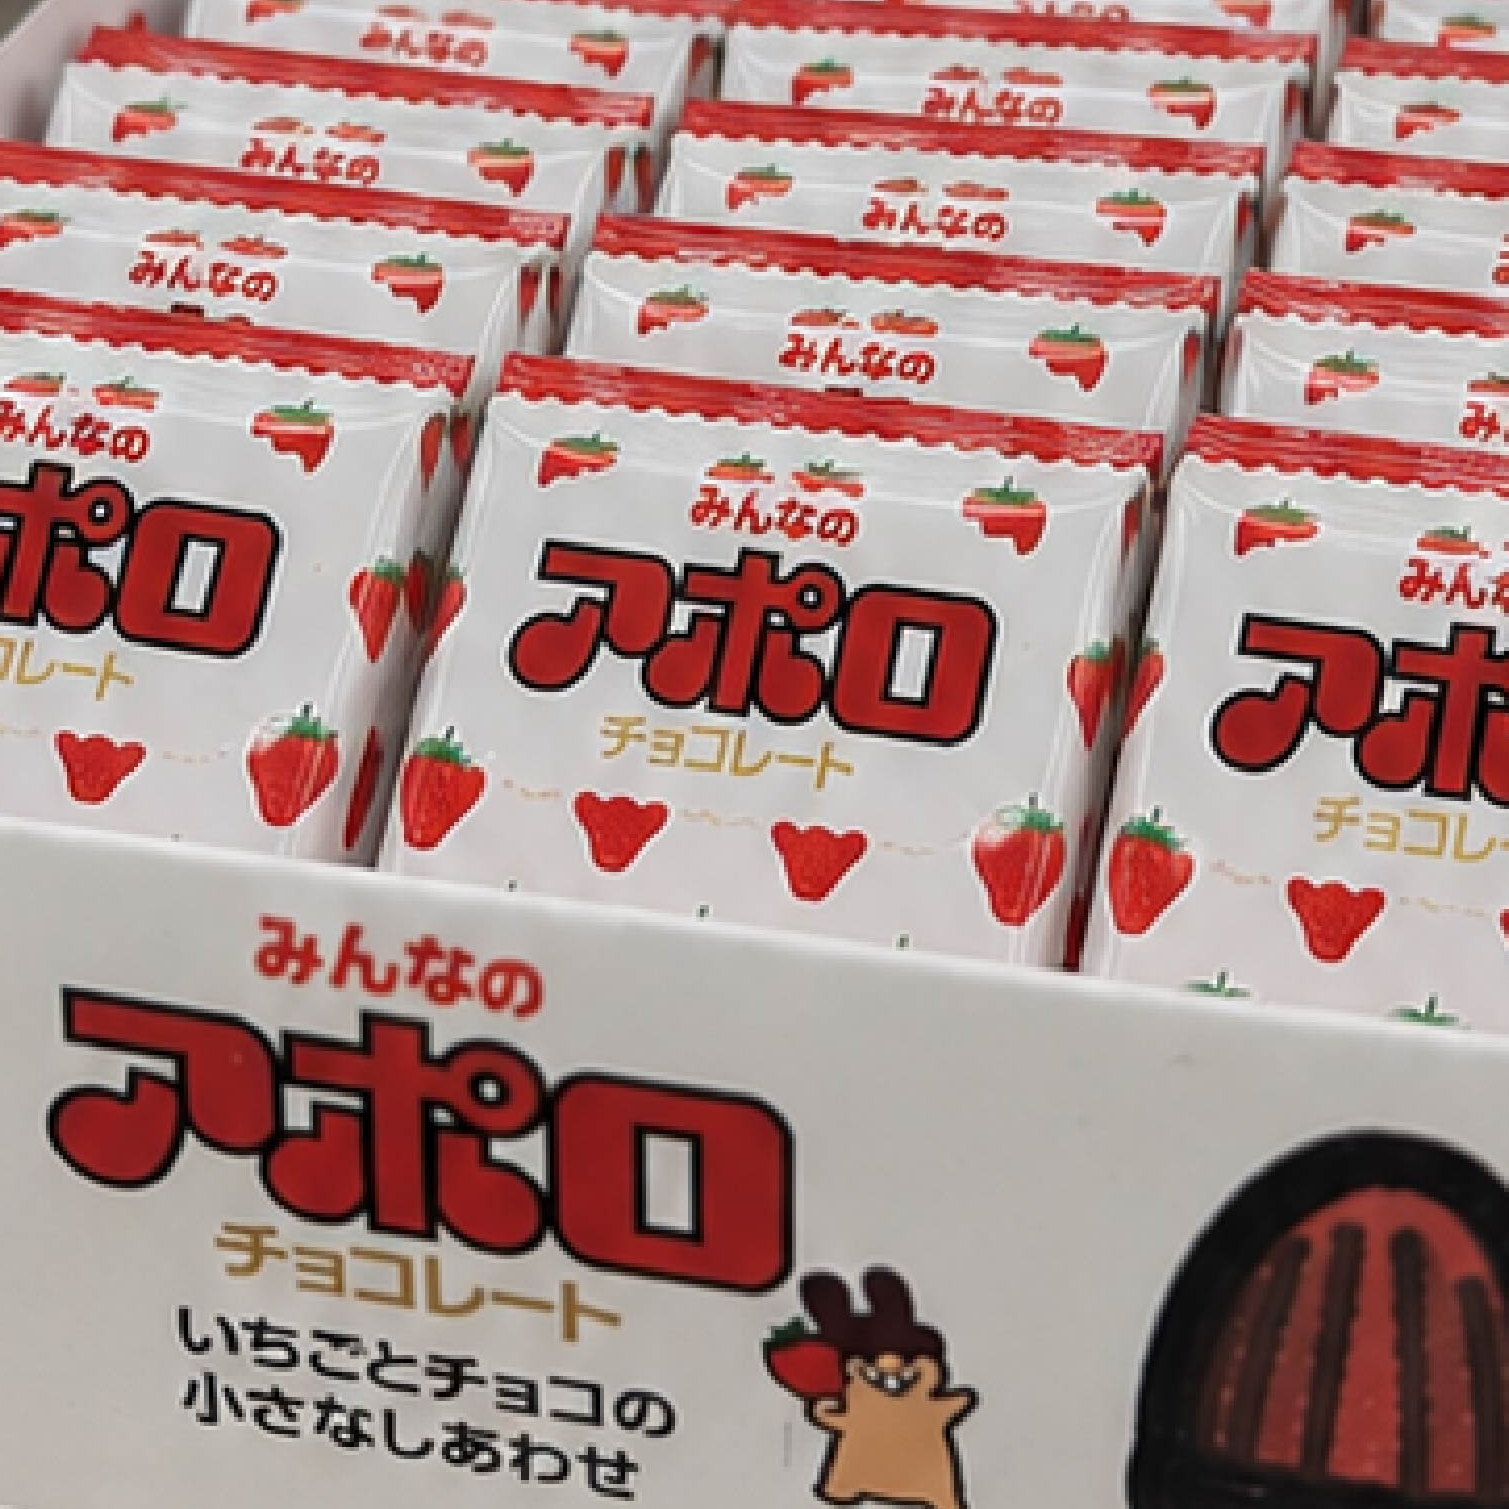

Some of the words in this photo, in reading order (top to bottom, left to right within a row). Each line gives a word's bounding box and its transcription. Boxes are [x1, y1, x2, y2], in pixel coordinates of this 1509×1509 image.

[129, 250, 278, 303] みんなの
[779, 333, 937, 385] みんなの
[691, 484, 859, 546] みんなの
[506, 538, 998, 747] アポロ
[599, 714, 855, 790] チョコレート
[255, 914, 544, 1018] みんなの
[47, 984, 795, 1293] アポロ
[214, 1220, 622, 1342] チョコレート
[176, 1305, 676, 1437] いちごとチョコの
[183, 1371, 640, 1501] 小さなしあわせ
